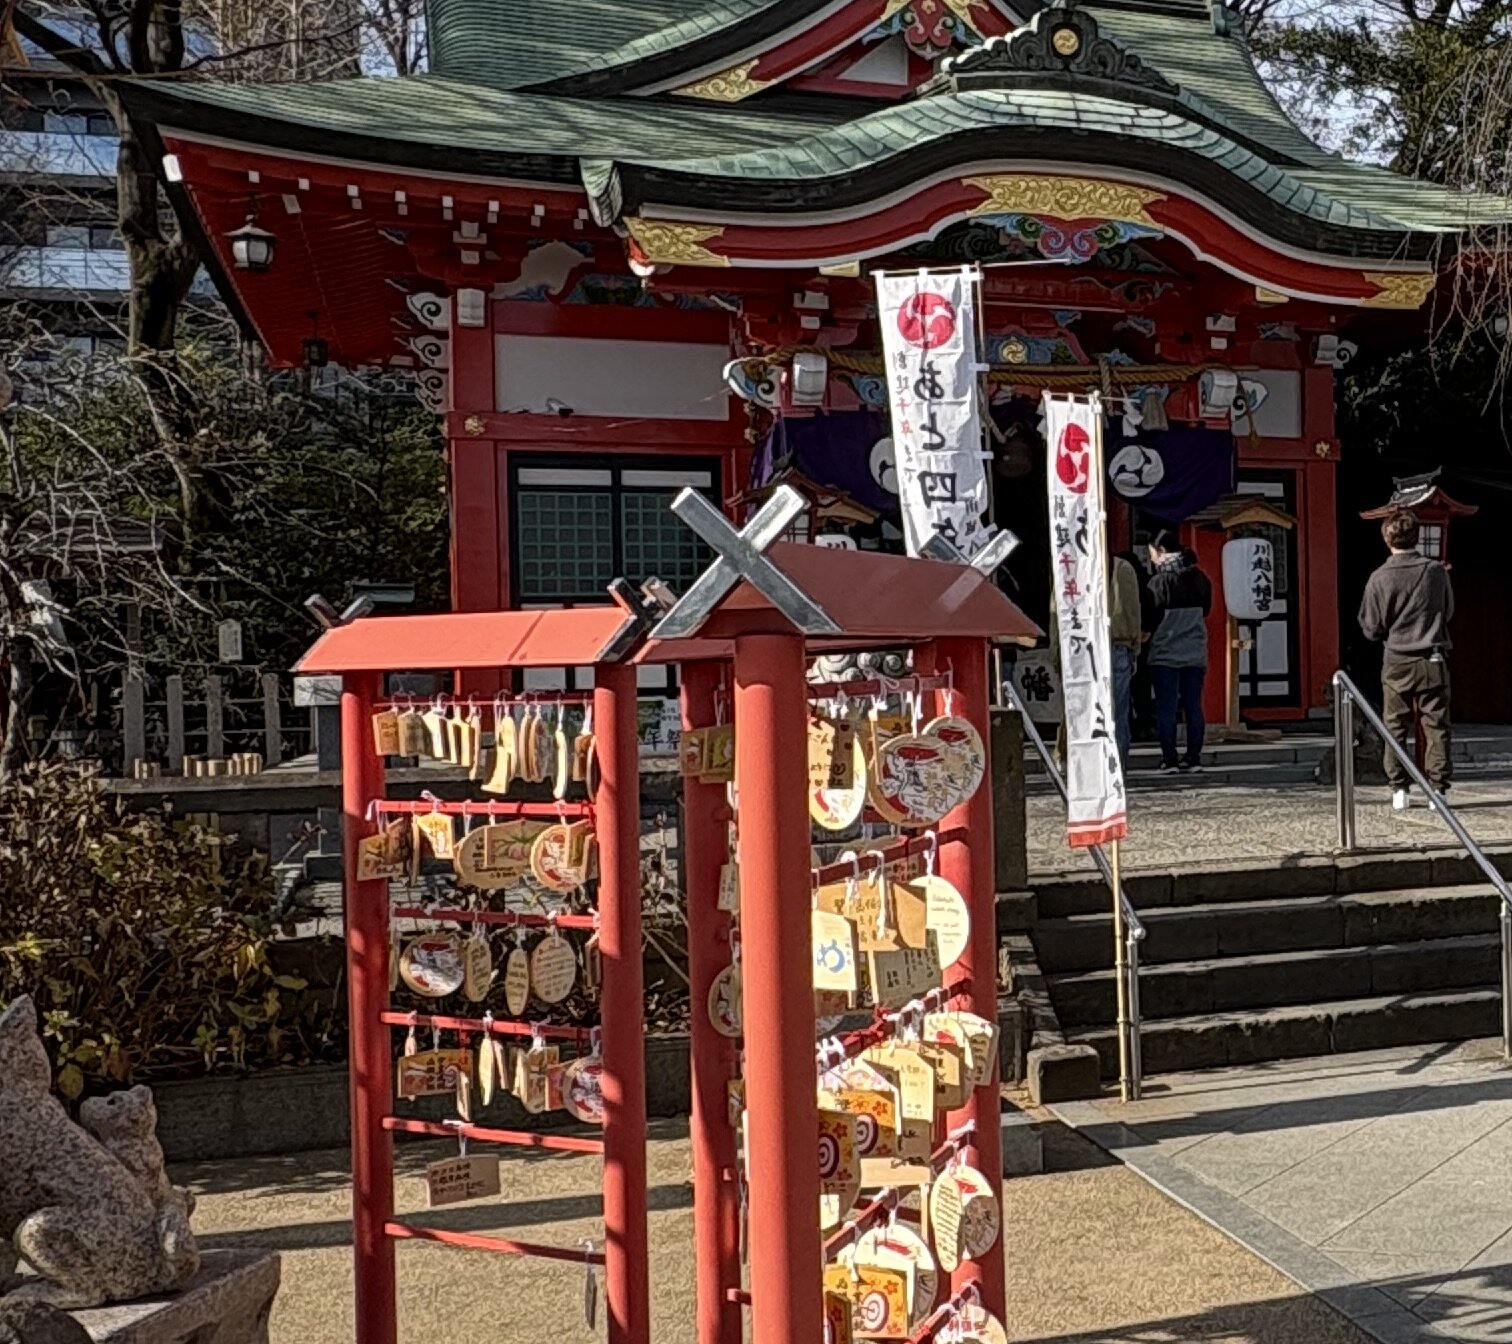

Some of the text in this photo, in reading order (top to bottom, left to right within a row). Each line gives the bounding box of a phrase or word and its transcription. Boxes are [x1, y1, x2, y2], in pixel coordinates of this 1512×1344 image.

[1251, 544, 1272, 611] 川越八幡宮
